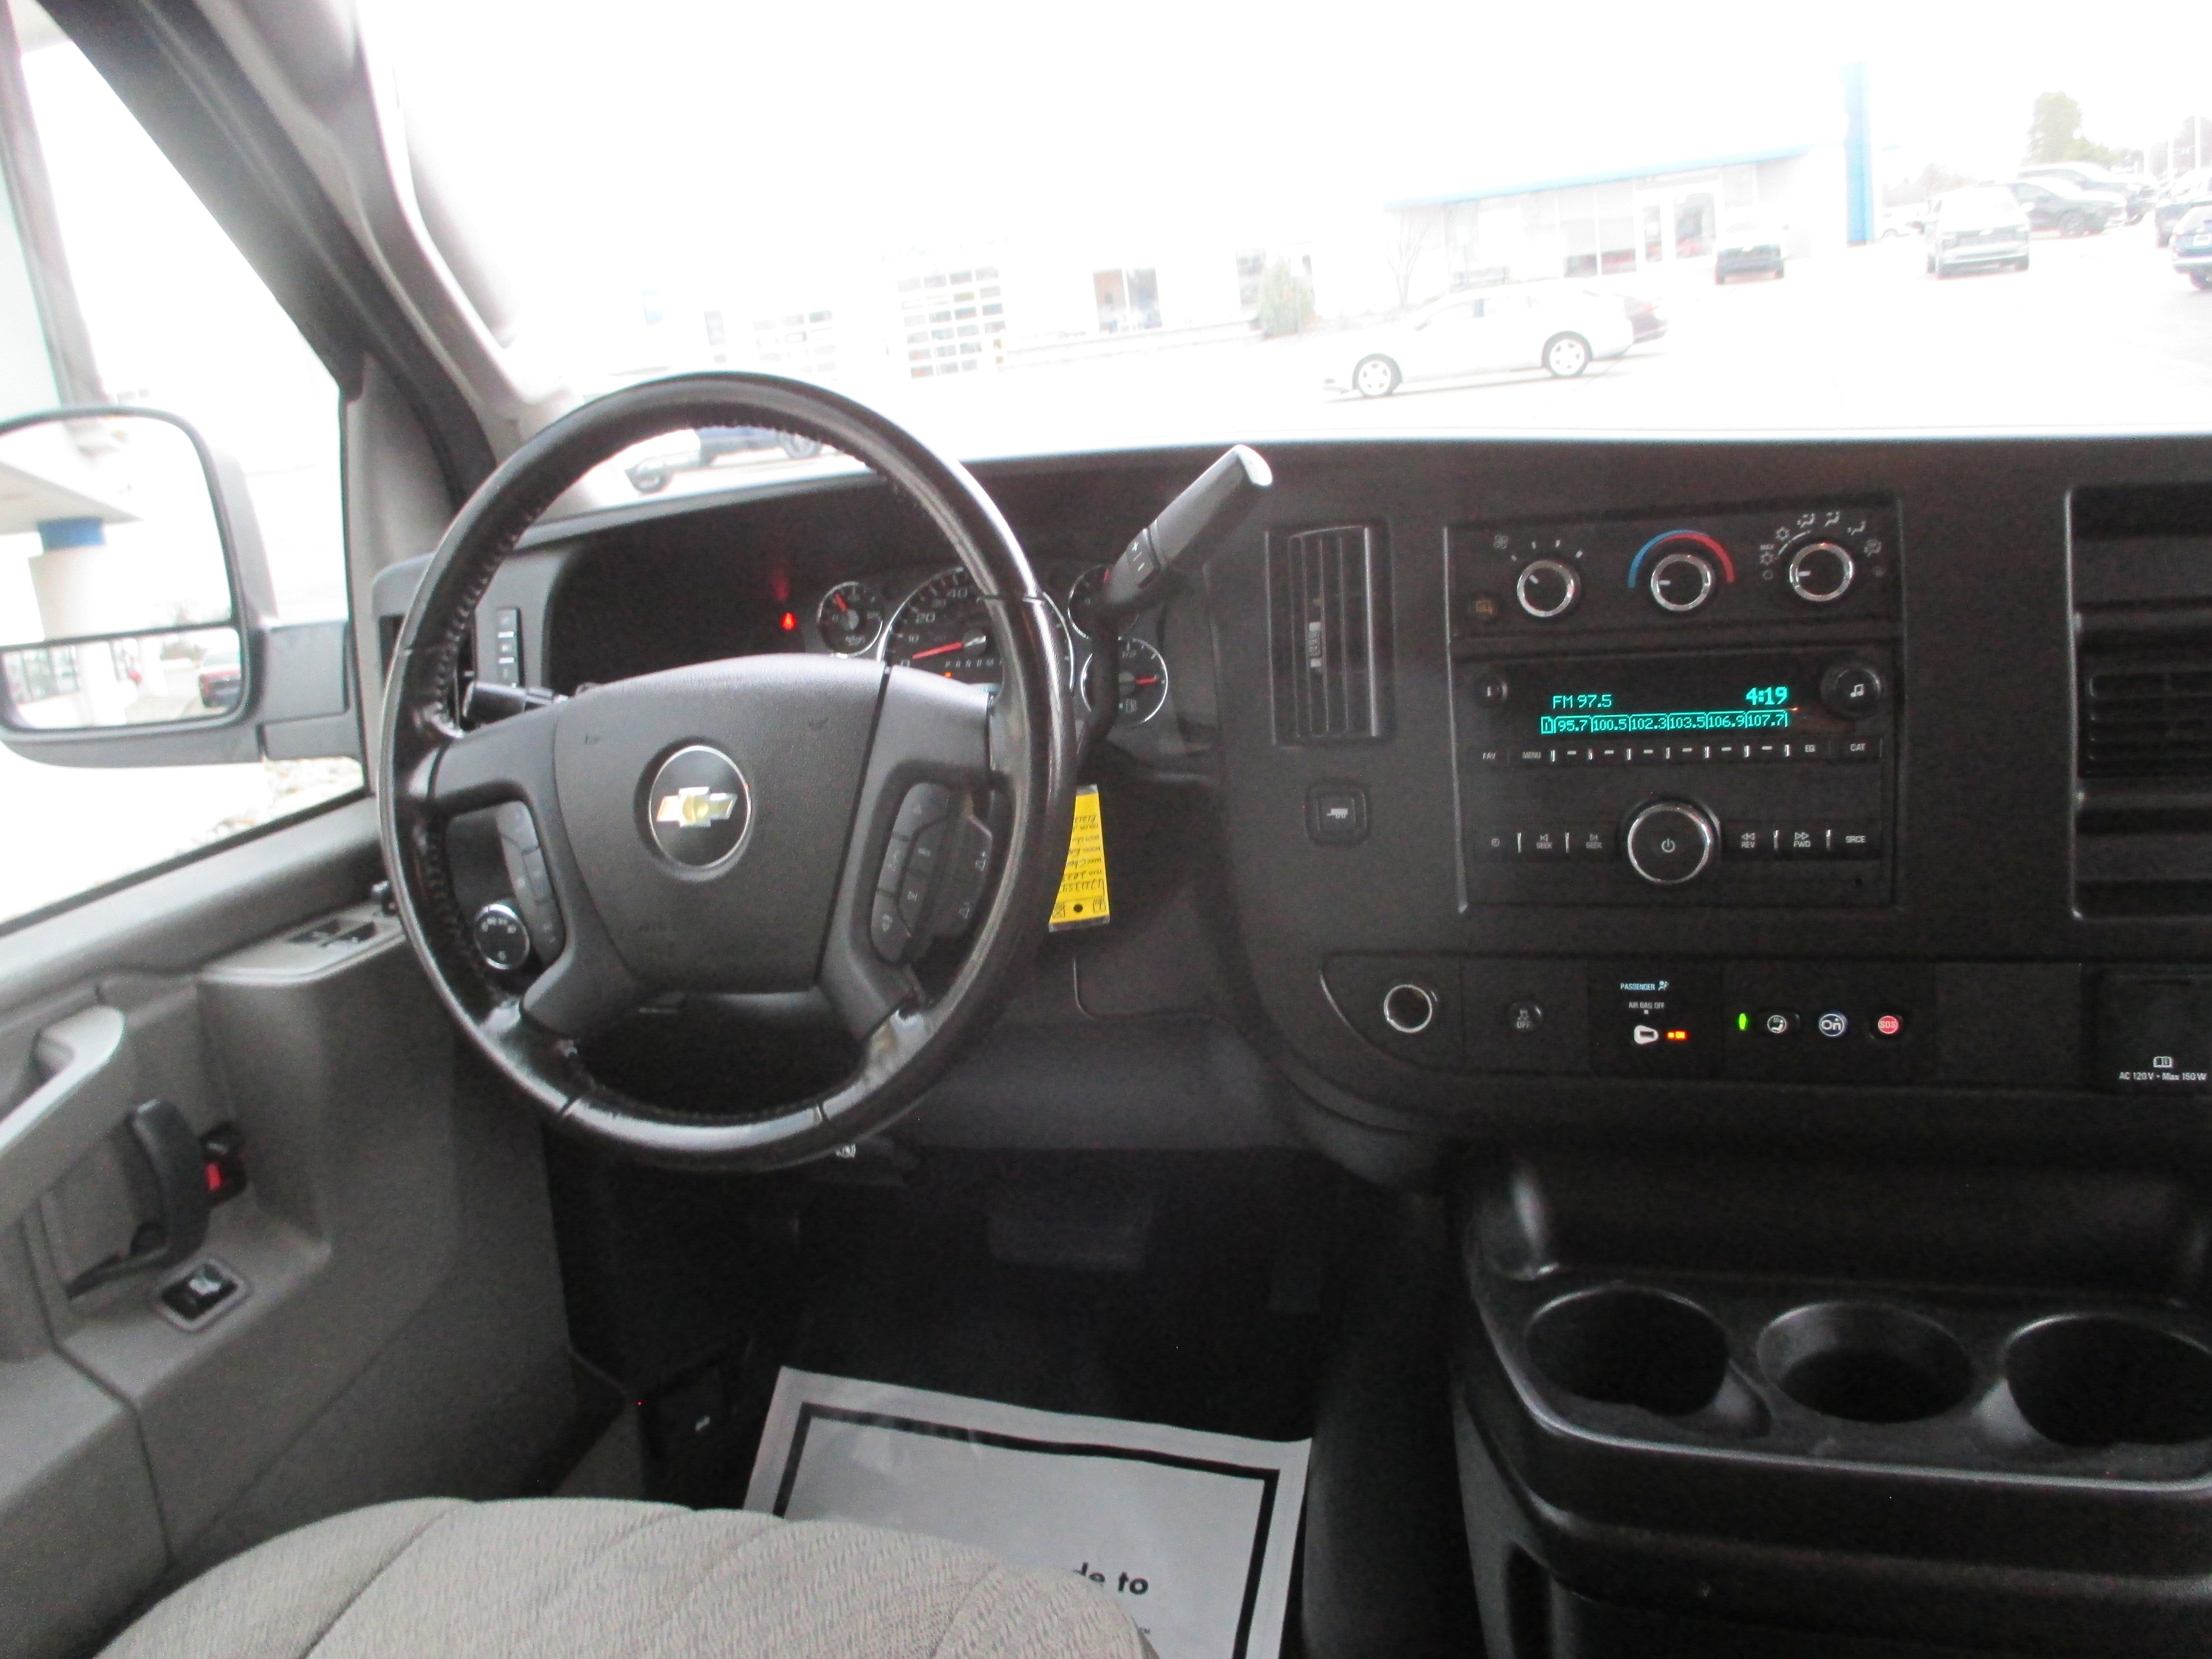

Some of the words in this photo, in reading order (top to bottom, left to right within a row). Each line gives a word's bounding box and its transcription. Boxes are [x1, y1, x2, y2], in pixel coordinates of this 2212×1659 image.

[947, 588, 968, 598] 40
[1745, 686, 1788, 706] 4:19
[1552, 695, 1573, 709] FM
[1577, 694, 1612, 708] 97.5
[1558, 720, 1587, 732] 95.7
[1594, 719, 1627, 731] 100.5
[1632, 718, 1667, 730] 102.3
[1670, 717, 1705, 729] 103.5
[1709, 715, 1744, 727] 106.9
[1748, 714, 1784, 727] 107.7
[1850, 743, 1865, 751] CAT
[1879, 1020, 1898, 1029] SOS
[1675, 1031, 1685, 1039] ON
[2118, 1071, 2130, 1080] AC
[1118, 1571, 1149, 1595] to
